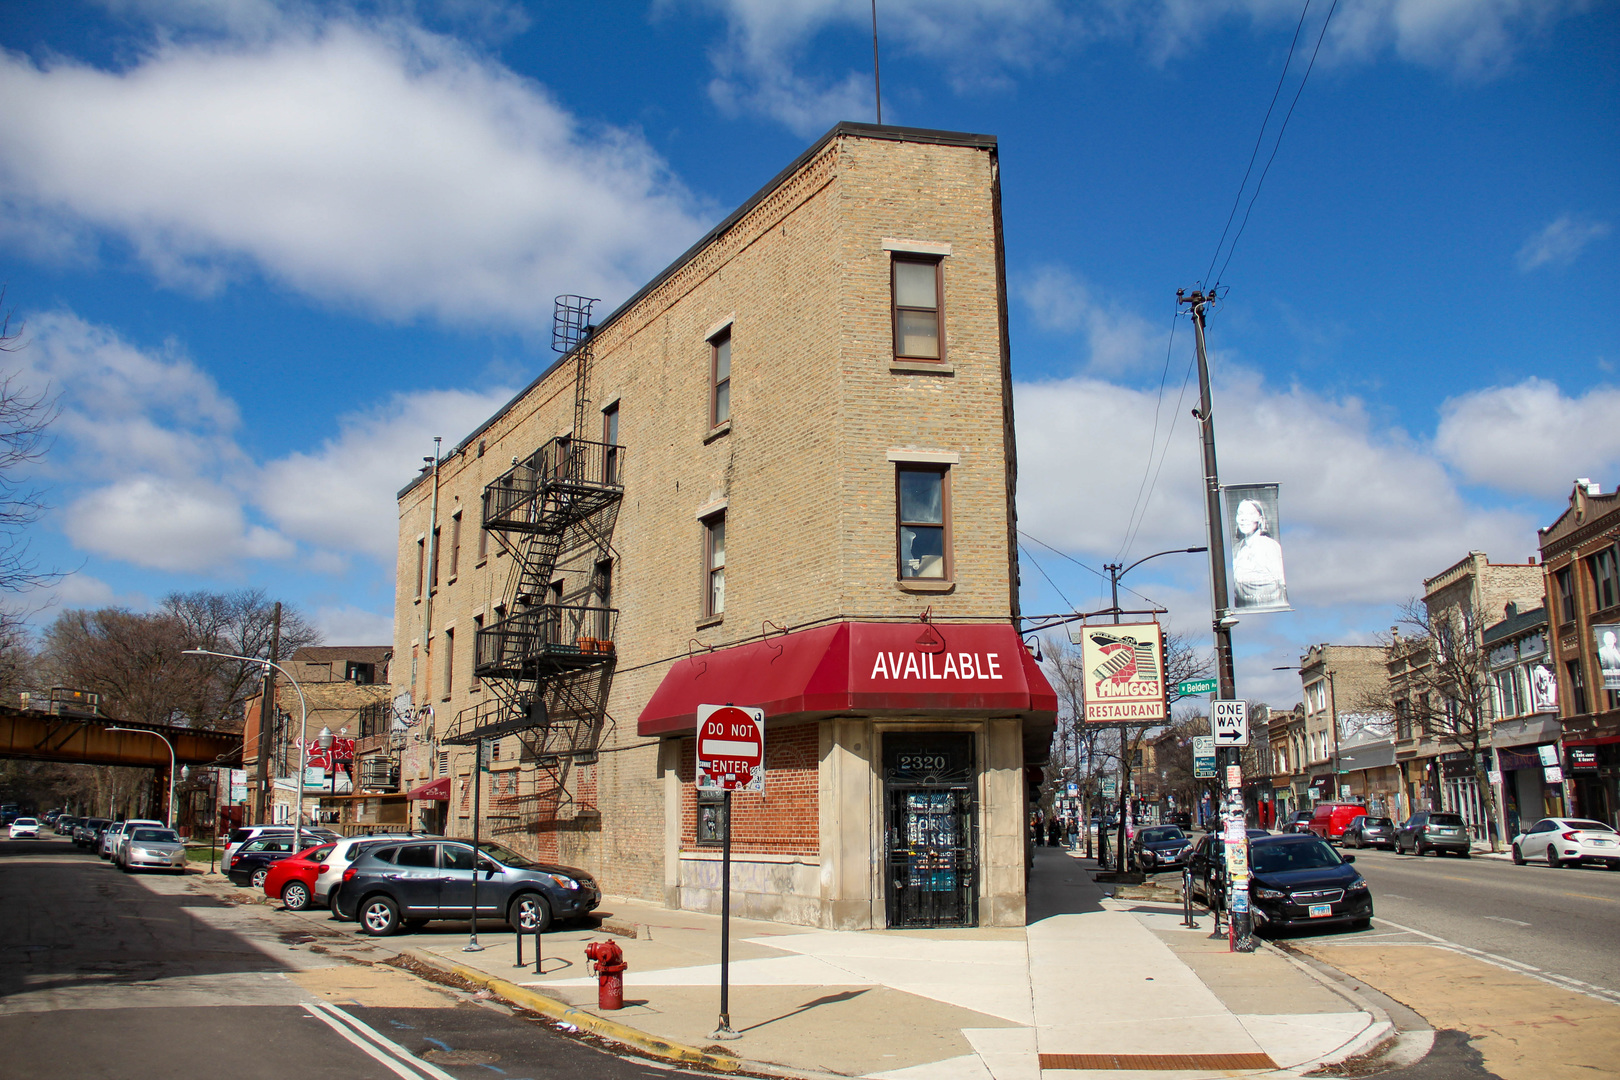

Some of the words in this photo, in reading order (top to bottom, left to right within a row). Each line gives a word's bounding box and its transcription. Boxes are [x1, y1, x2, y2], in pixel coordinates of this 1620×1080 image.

[870, 651, 1004, 680] AVAILABLE
[1098, 679, 1158, 697] AMIGOS
[1186, 682, 1210, 693] Belden
[1088, 704, 1161, 718] RESTAURANT
[1217, 704, 1243, 715] ONE
[1217, 716, 1243, 727] WAY
[708, 722, 724, 736] DO
[731, 723, 754, 738] NOT
[712, 759, 749, 774] ENTER
[901, 756, 946, 770] 2320
